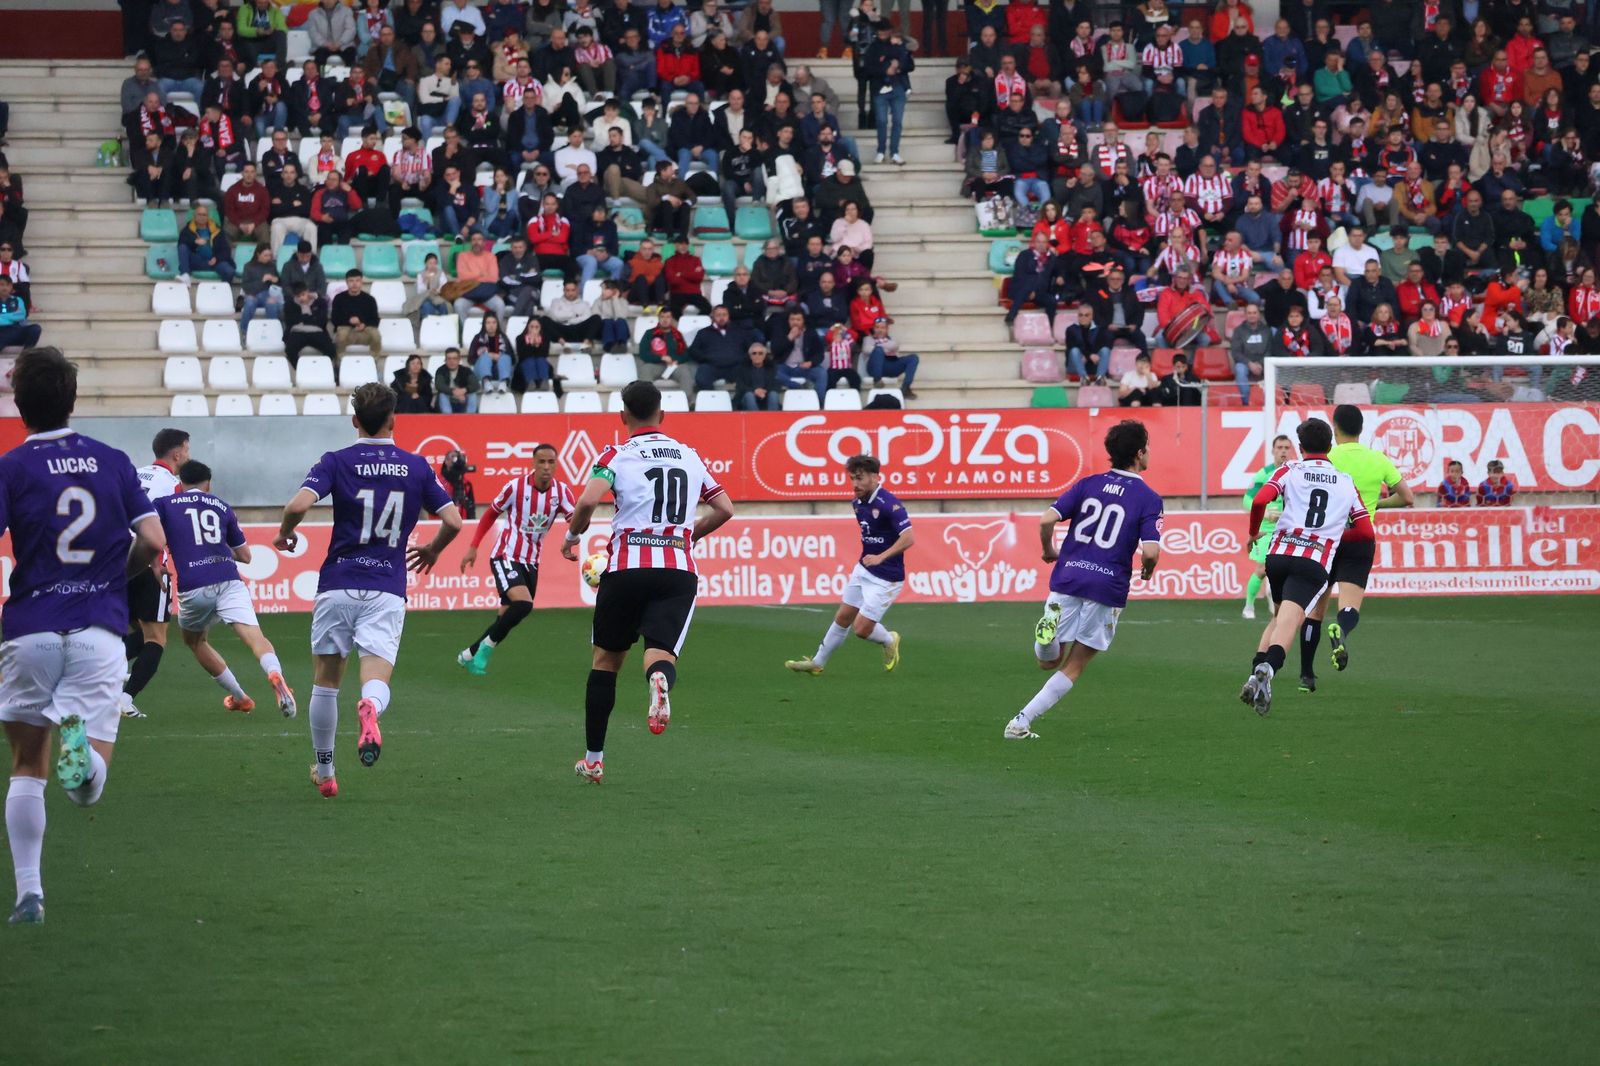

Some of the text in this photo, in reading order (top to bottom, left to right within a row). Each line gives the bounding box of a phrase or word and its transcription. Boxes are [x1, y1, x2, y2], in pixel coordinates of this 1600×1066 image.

[640, 447, 682, 459] C. RAMOS
[47, 457, 98, 475] LUCAS
[355, 463, 409, 477] TAVARES
[927, 472, 937, 484] Y
[944, 470, 1050, 484] JAMONES
[1303, 472, 1337, 484] MARCELO
[644, 467, 688, 525] 10
[1102, 483, 1125, 496] MIKI
[170, 495, 228, 513] PABLO MUÑOZ
[1304, 488, 1329, 528] 8
[56, 486, 96, 564] 2
[184, 508, 221, 546] 19
[355, 489, 405, 548] 14
[1074, 497, 1126, 549] 20
[627, 534, 685, 549] leomotor.net
[758, 528, 836, 559] Joven
[425, 573, 480, 589] Junta
[778, 573, 795, 605] y
[801, 565, 852, 596] Leó
[1368, 574, 1592, 591] .bodegasdelsumiller.com
[259, 602, 288, 613] león
[446, 595, 458, 610] y
[319, 752, 332, 763] FS
